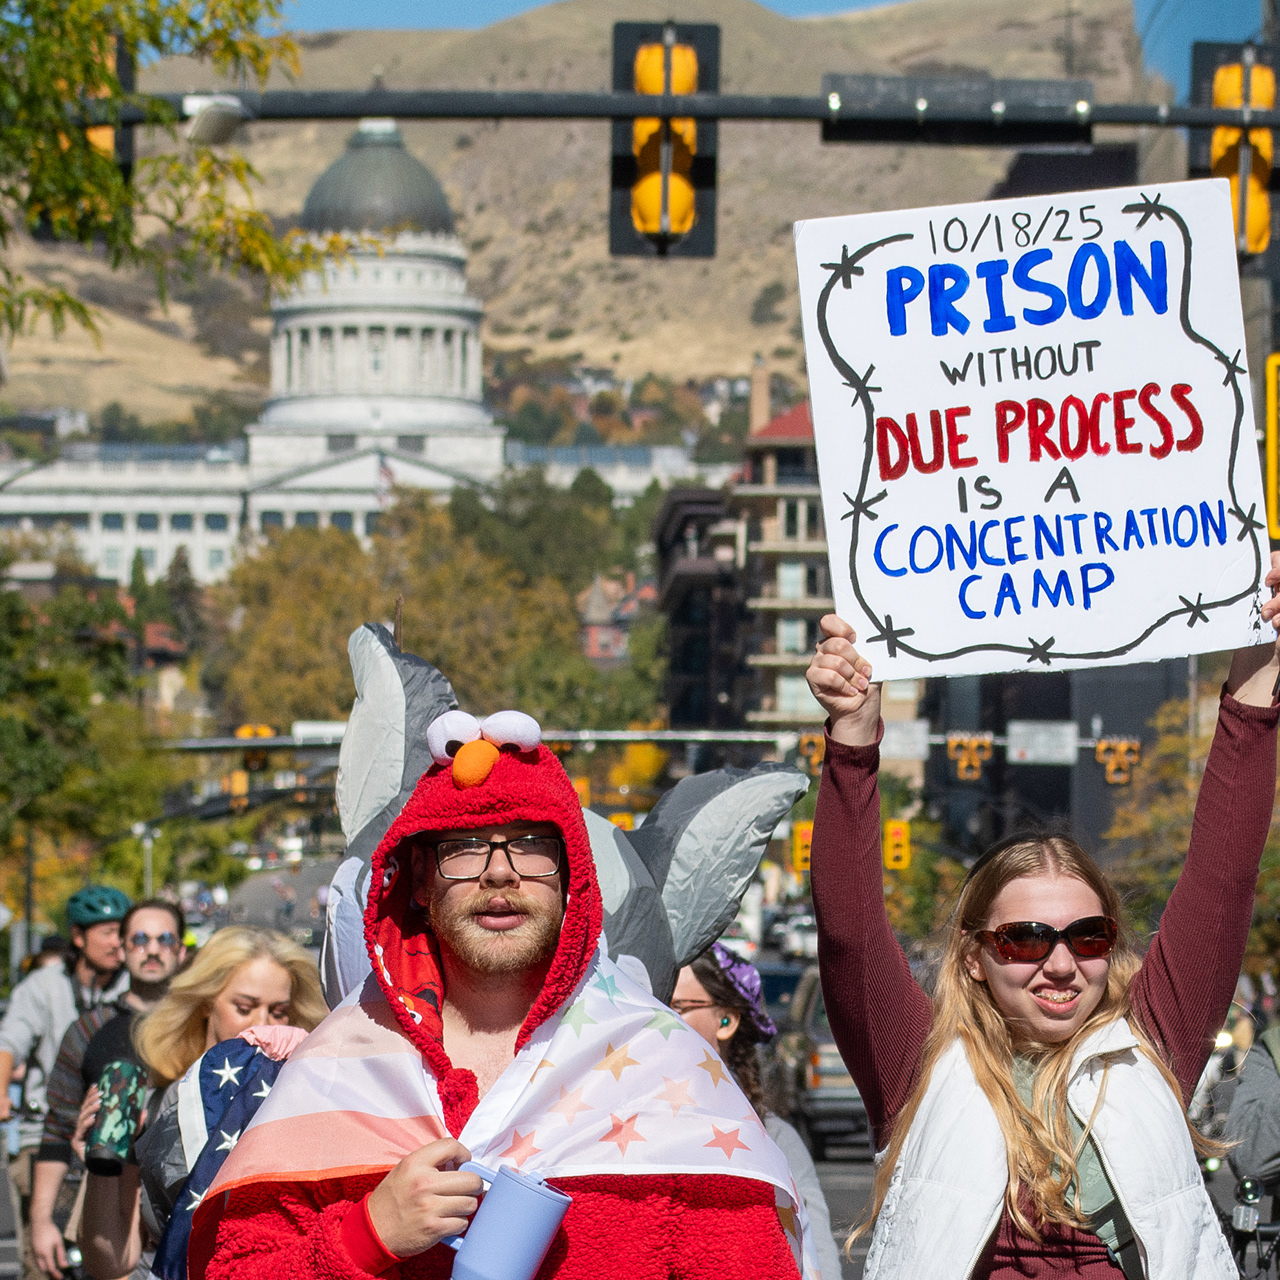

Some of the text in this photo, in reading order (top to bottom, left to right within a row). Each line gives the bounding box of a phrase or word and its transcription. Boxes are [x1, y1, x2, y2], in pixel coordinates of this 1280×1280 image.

[930, 206, 1103, 254] 10/18/25
[886, 240, 1168, 336] PRISON
[940, 341, 1101, 386] WITHOUT
[877, 383, 1203, 482] DUE PROCESS
[959, 467, 1080, 512] IS A
[874, 500, 1227, 578] CONCENTRATION
[959, 562, 1115, 618] CAMP
